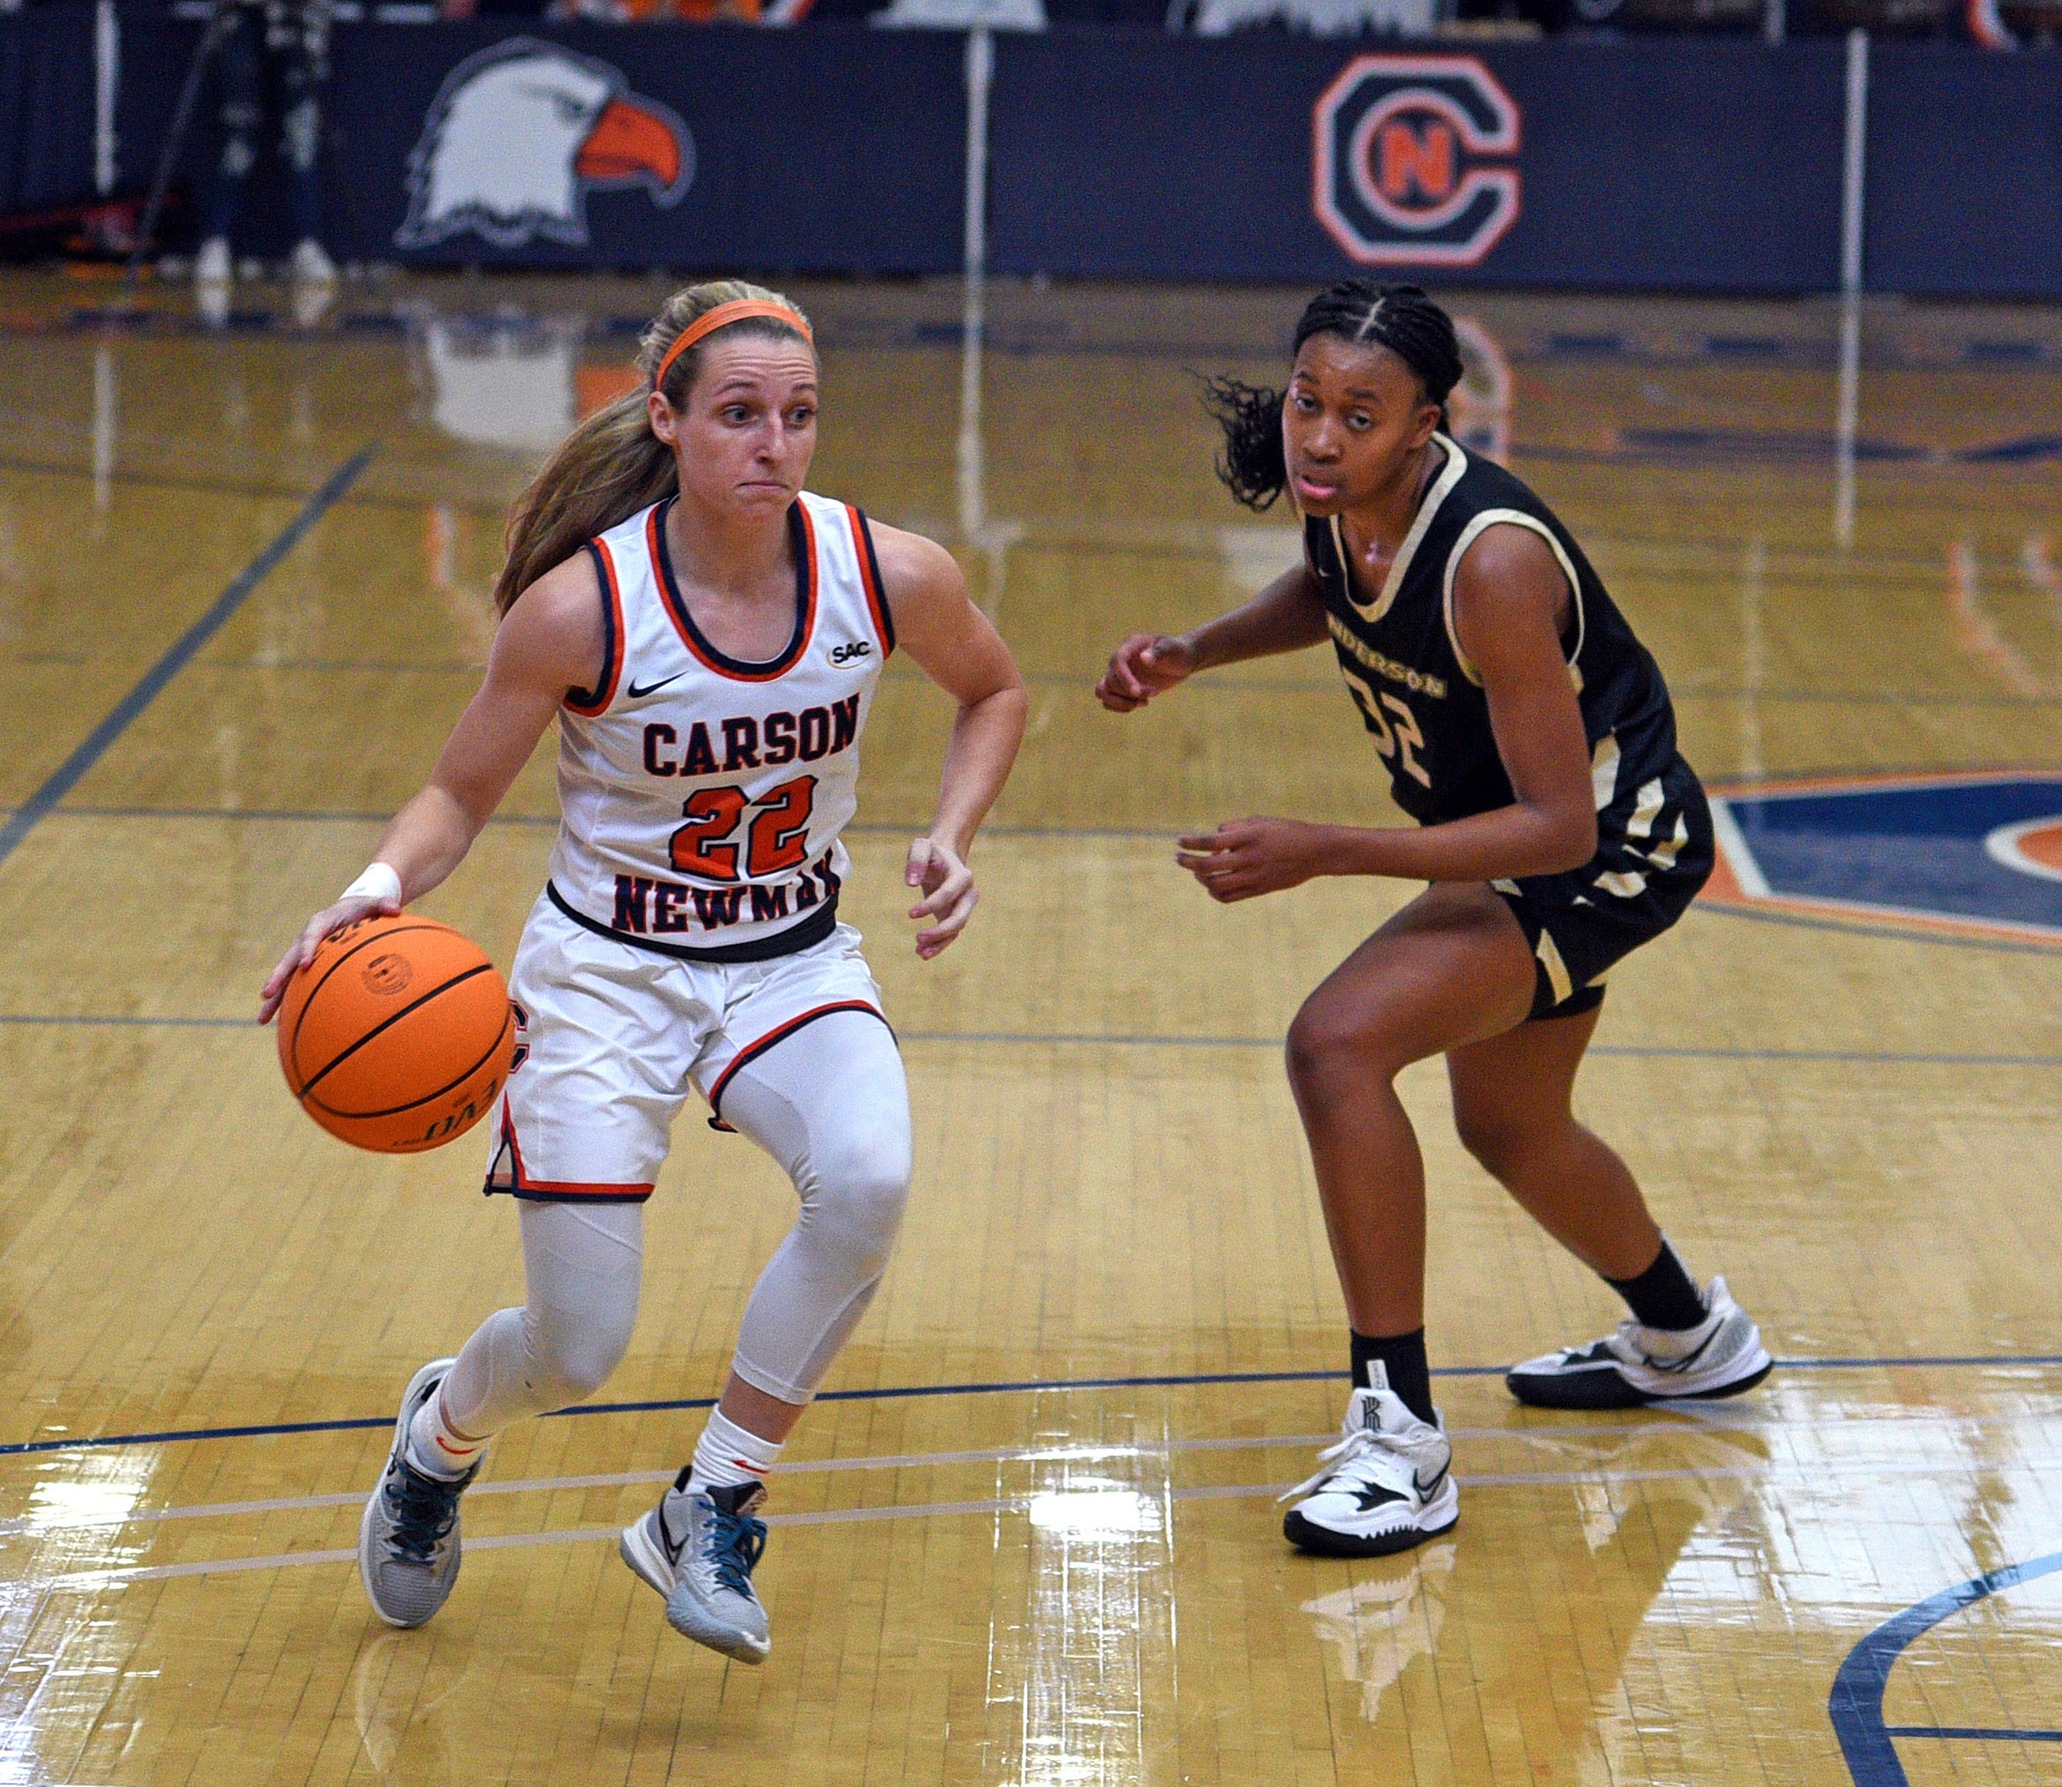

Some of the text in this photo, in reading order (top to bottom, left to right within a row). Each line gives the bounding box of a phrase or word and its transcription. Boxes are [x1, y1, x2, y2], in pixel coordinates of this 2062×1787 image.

[832, 641, 870, 664] SAC
[1325, 610, 1447, 698] NDERSON
[643, 692, 861, 777] CARSON
[669, 775, 819, 882] 22
